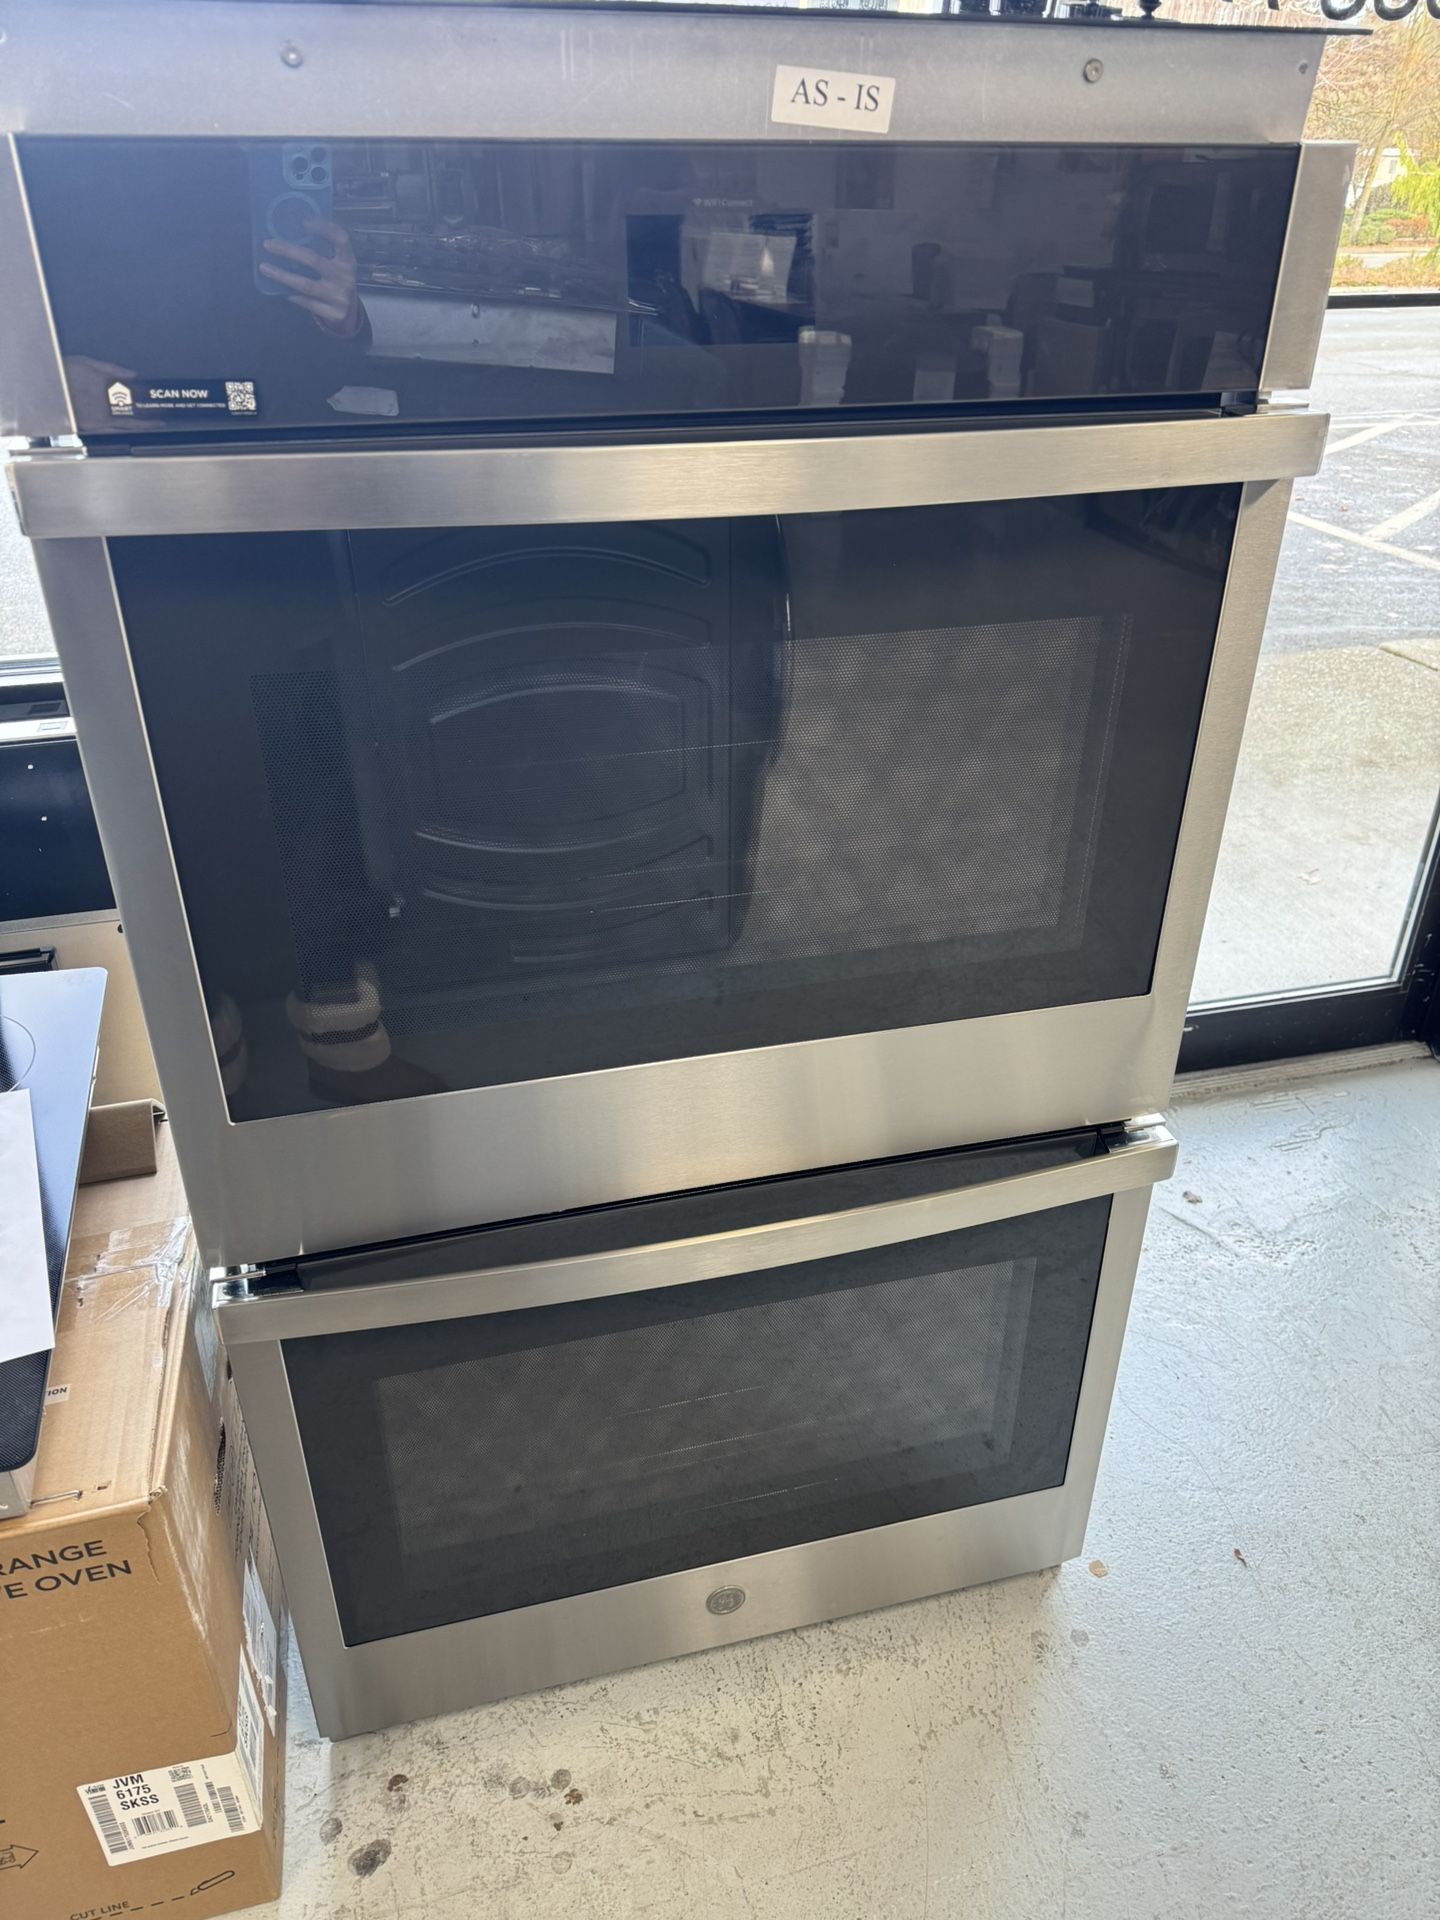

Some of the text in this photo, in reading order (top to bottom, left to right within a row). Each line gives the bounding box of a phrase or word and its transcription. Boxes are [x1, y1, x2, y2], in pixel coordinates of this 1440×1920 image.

[790, 77, 829, 106] AS
[854, 83, 880, 112] IS
[149, 389, 209, 399] SCAN NOW
[46, 1386, 68, 1397] ION
[35, 1560, 132, 1591] OVEN
[113, 1774, 144, 1790] JVM
[116, 1784, 152, 1800] 6175
[120, 1794, 160, 1811] SKSS
[70, 1901, 130, 1920] CUT LINE
